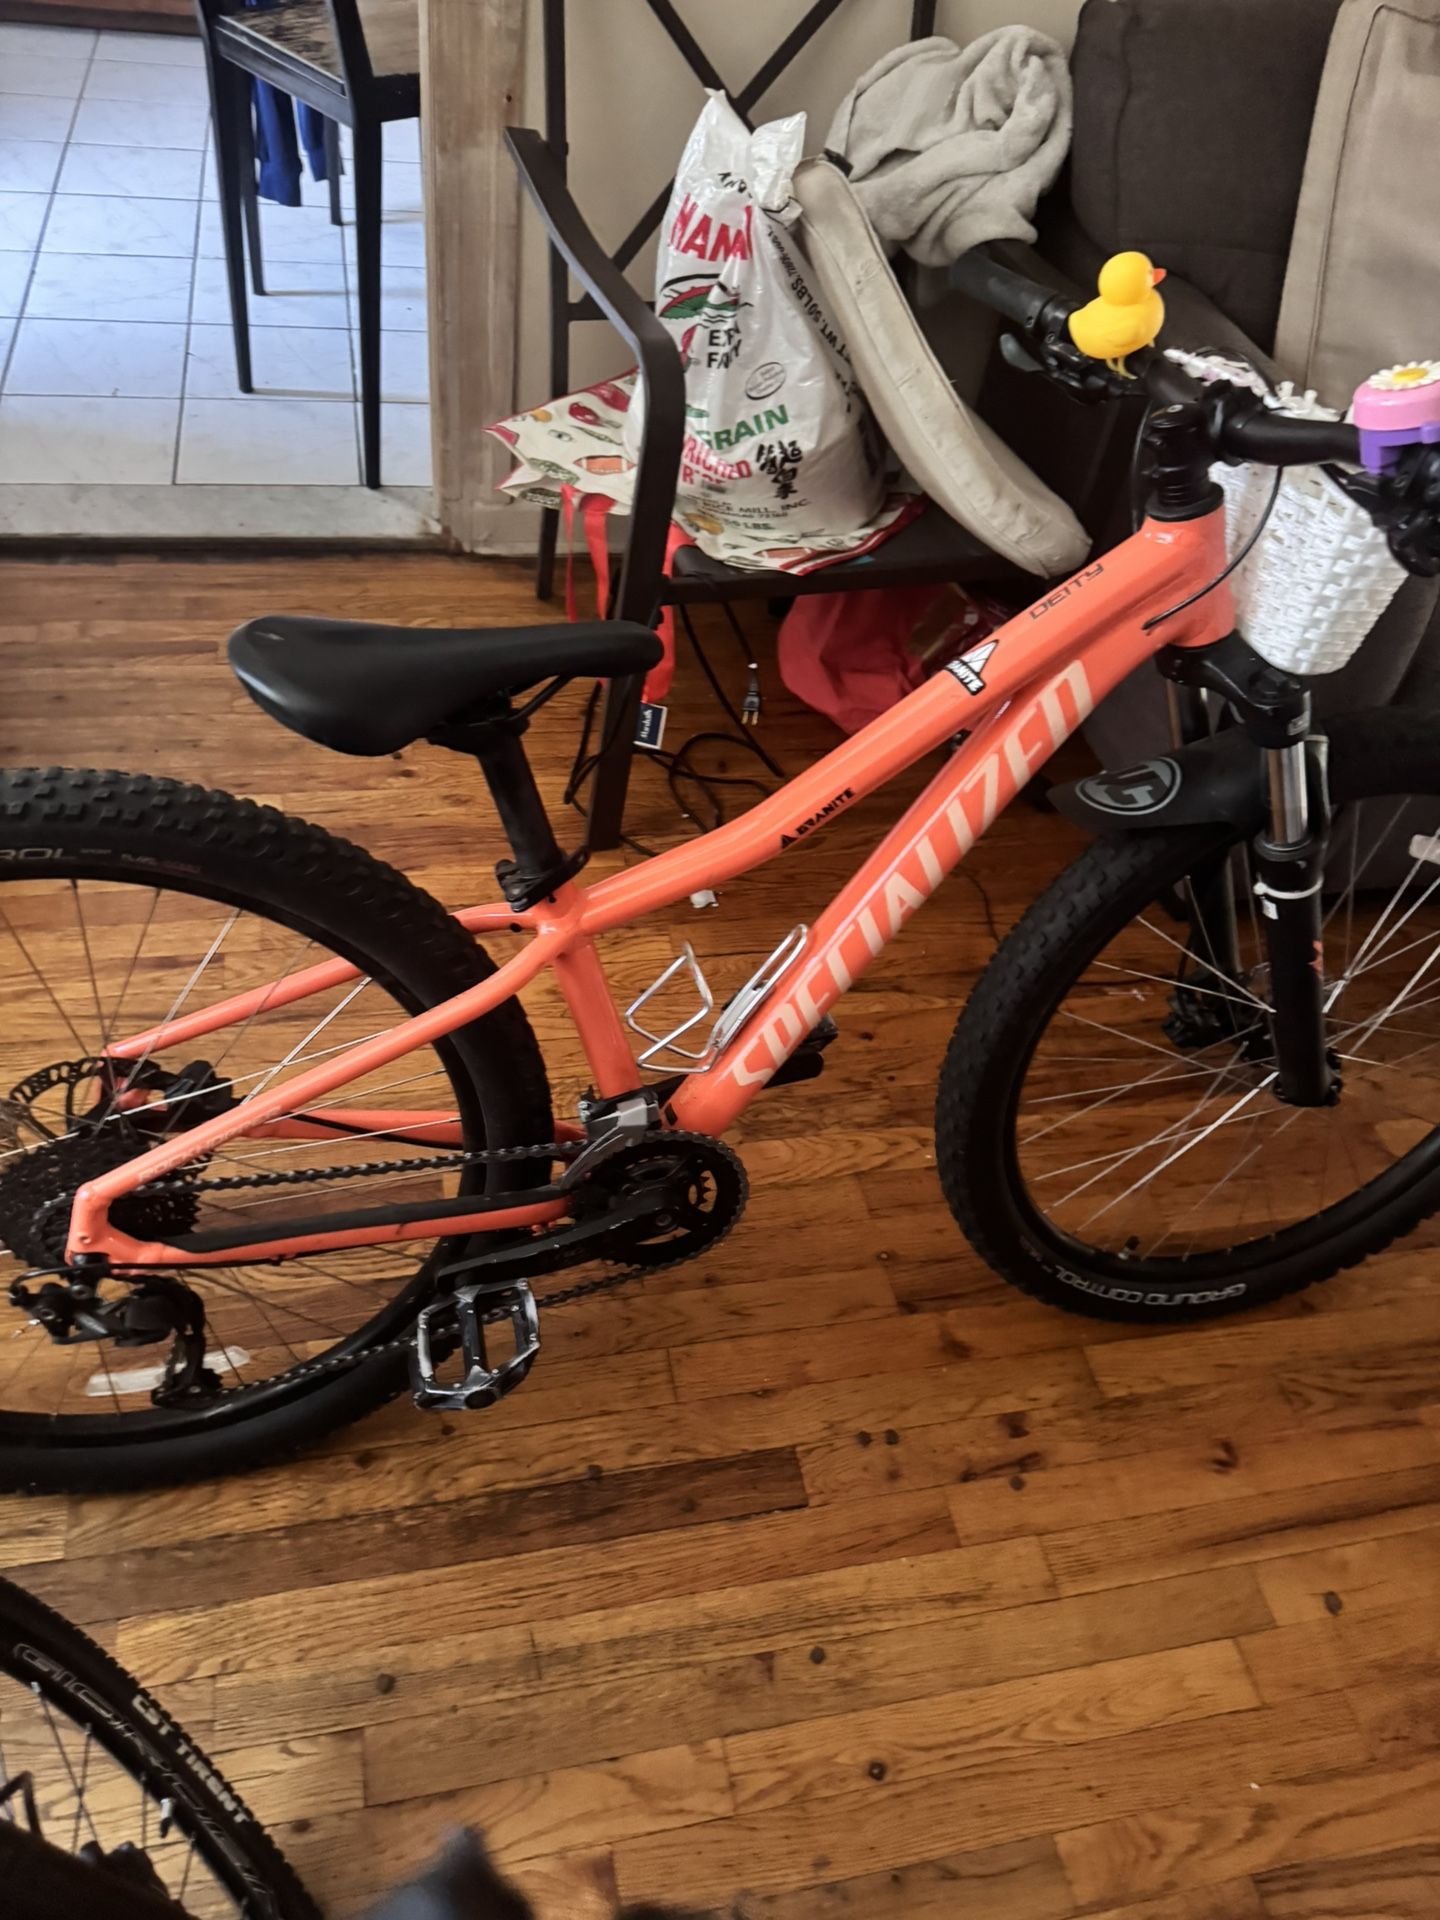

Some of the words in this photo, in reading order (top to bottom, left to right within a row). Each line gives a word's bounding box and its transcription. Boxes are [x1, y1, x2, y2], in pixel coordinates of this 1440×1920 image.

[1028, 563, 1105, 620] DEITY
[1053, 1263, 1144, 1304] CONTROL
[1143, 1282, 1248, 1306] GROUND
[131, 1694, 177, 1737] CST
